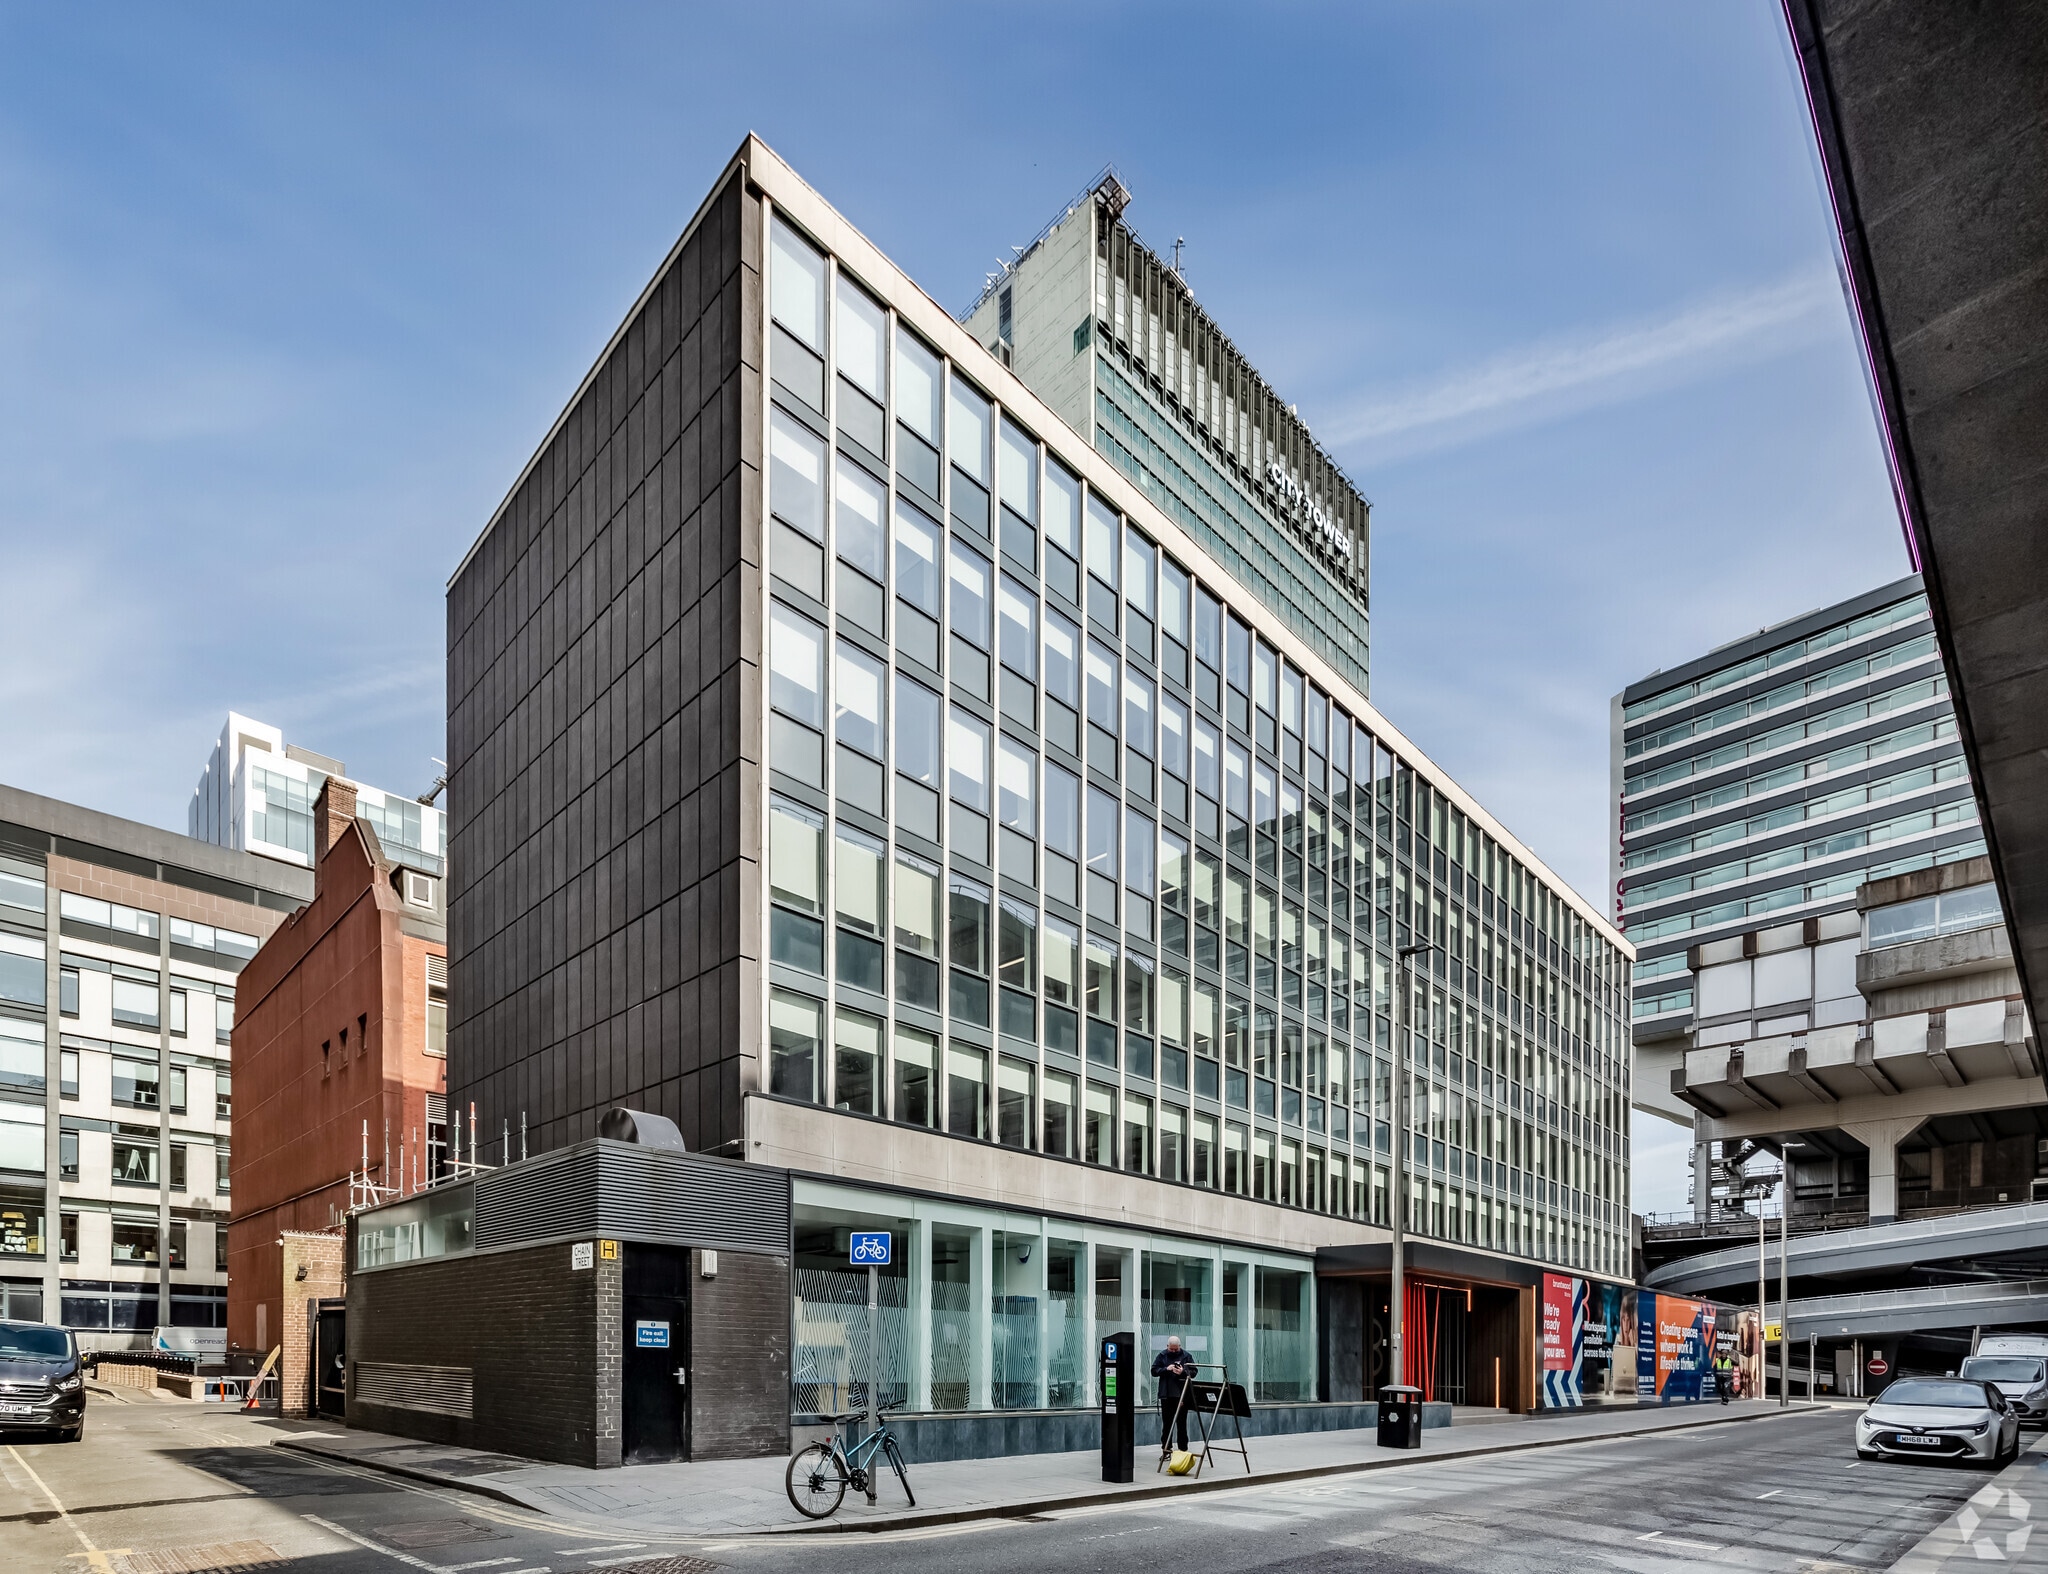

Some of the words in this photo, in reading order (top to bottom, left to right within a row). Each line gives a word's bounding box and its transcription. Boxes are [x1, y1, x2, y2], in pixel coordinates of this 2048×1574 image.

[1271, 463, 1303, 507] CITY
[1304, 496, 1351, 559] TOWER
[574, 1244, 591, 1256] CHAIN
[604, 1242, 614, 1257] H
[1544, 1303, 1559, 1316] We're
[1544, 1318, 1560, 1333] ready
[1584, 1321, 1606, 1333] Workspace
[1660, 1321, 1682, 1339] Creating
[1682, 1327, 1698, 1340] spaces
[1544, 1332, 1559, 1344] when
[1584, 1334, 1602, 1344] available
[1108, 1344, 1115, 1358] P
[1660, 1338, 1677, 1353] where
[1677, 1340, 1689, 1354] work
[1544, 1348, 1555, 1360] you
[1555, 1349, 1566, 1358] are.
[1584, 1349, 1598, 1357] across
[1660, 1355, 1680, 1373] lifestyle
[1680, 1357, 1695, 1371] thrive.
